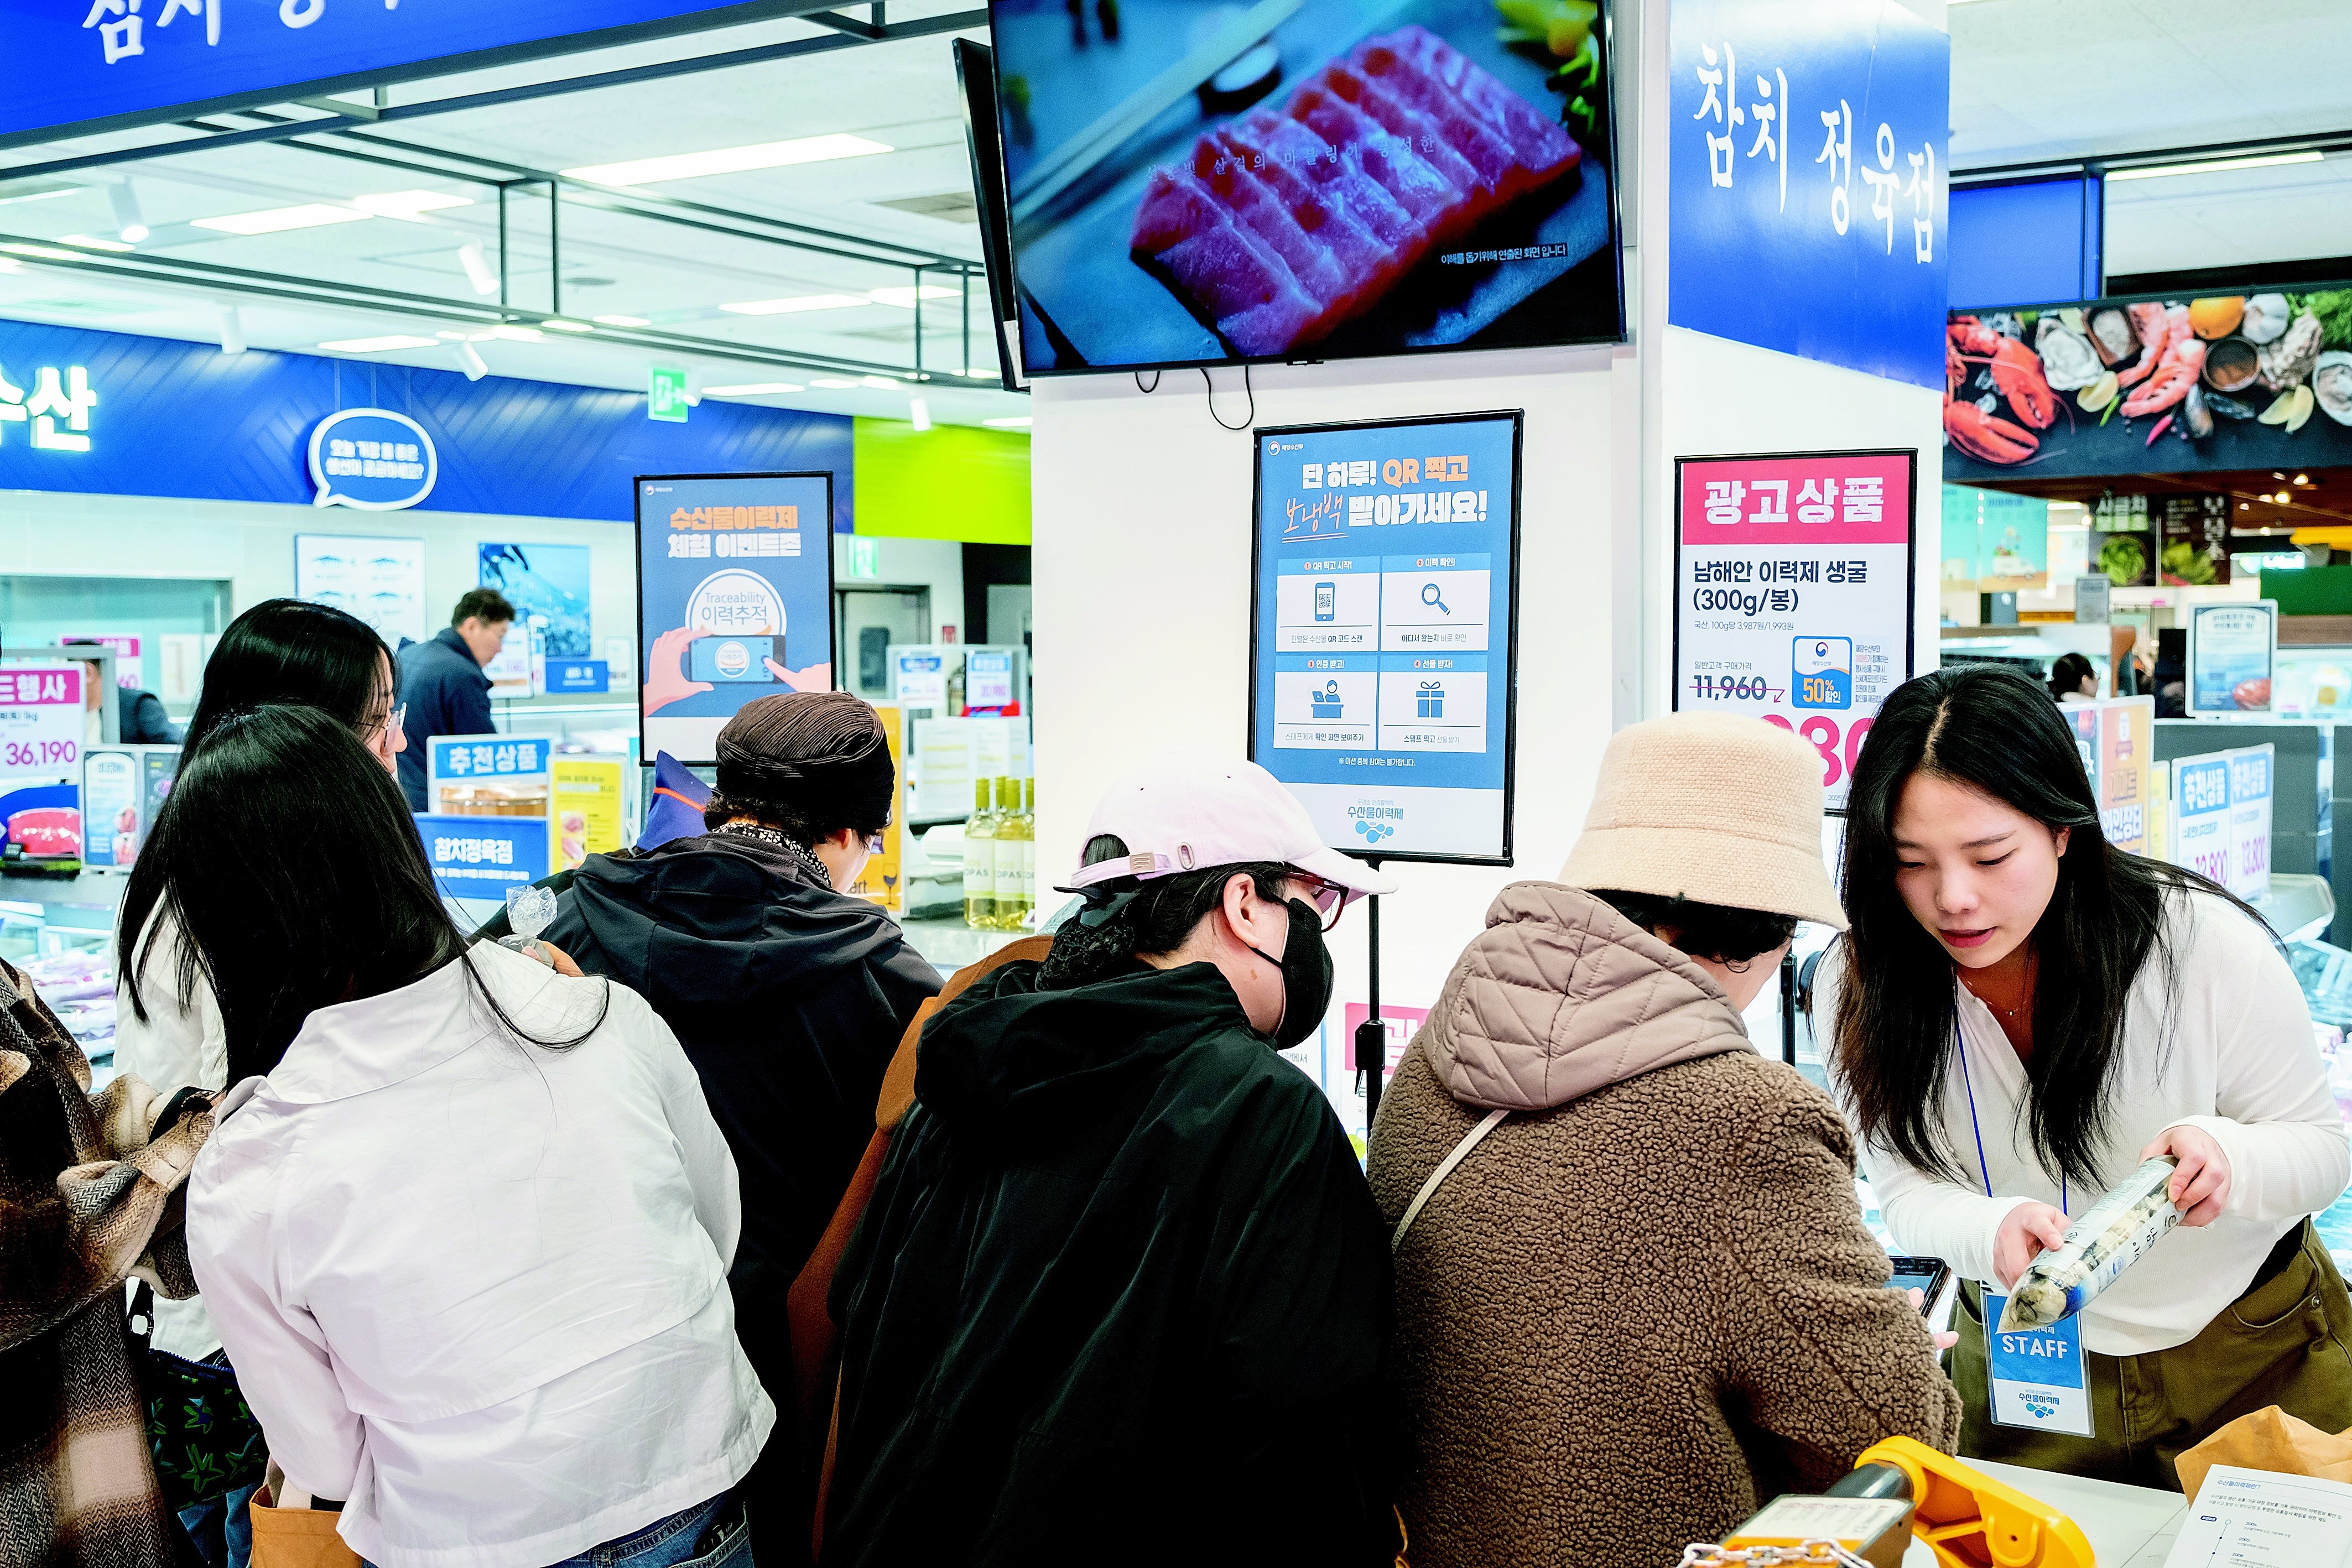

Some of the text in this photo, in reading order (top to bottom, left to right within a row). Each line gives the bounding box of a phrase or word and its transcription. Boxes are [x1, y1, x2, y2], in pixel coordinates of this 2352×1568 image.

[1693, 40, 1935, 264] 참치 정육점
[1441, 243, 1566, 265] 이해를 돕기위해 연출된 화면 입니다
[1302, 455, 1469, 489] 단 하루! QR 찍고
[1704, 477, 1885, 525] 광고상품
[670, 506, 798, 531] 수산물이력제
[1283, 489, 1488, 534] 보냉백 받아가세요!
[668, 533, 802, 558] 체험 이벤트존
[1313, 562, 1323, 570] QR
[1324, 561, 1336, 570] 찍고
[1337, 560, 1352, 570] 시작!
[1425, 558, 1438, 567] 이력
[1440, 557, 1455, 567] 확인!
[1694, 560, 1867, 584] 남해안 이력제 생굴
[704, 592, 766, 605] Traceability
[1693, 588, 1798, 617] (300g/봉)
[701, 605, 767, 626] 이력추적
[1694, 621, 1794, 632] 국산, 100g당 3,987원/1,993원
[1291, 634, 1308, 643] 진열된
[1309, 634, 1326, 643] 수산물
[1338, 634, 1350, 643] 코드
[1351, 634, 1363, 643] 스캔
[1402, 633, 1467, 642] 어디서 왔는지 바로 확인
[1856, 644, 1881, 653] 해양수산부와
[1315, 659, 1328, 669] 인증
[1330, 659, 1345, 669] 받고!
[1422, 659, 1436, 669] 선물
[1437, 659, 1453, 669] 받자!
[1694, 660, 1752, 670] 일반고객 구매가격
[1694, 675, 1767, 701] 11,960
[1825, 690, 1841, 704] 할인
[1315, 733, 1326, 741] 확인
[1328, 733, 1340, 742] 화면
[1341, 733, 1365, 742] 보여주기
[1403, 734, 1422, 743] 스탬프
[1423, 734, 1435, 743] 찍고
[6, 740, 76, 766] 36,190
[449, 743, 538, 775] 추천상품
[1345, 757, 1356, 765] 미션
[1357, 757, 1368, 765] 중복
[1369, 757, 1386, 766] 참여는
[1386, 758, 1416, 767] 불가합니다.
[2184, 767, 2226, 811] 추천상품
[1347, 806, 1403, 820] 수산물이력제
[434, 837, 513, 864] 참치정육점
[2002, 1335, 2068, 1359] STAFF
[2018, 1392, 2060, 1406] 수산물이력제
[2217, 1480, 2261, 1490] 수산물이력제란?
